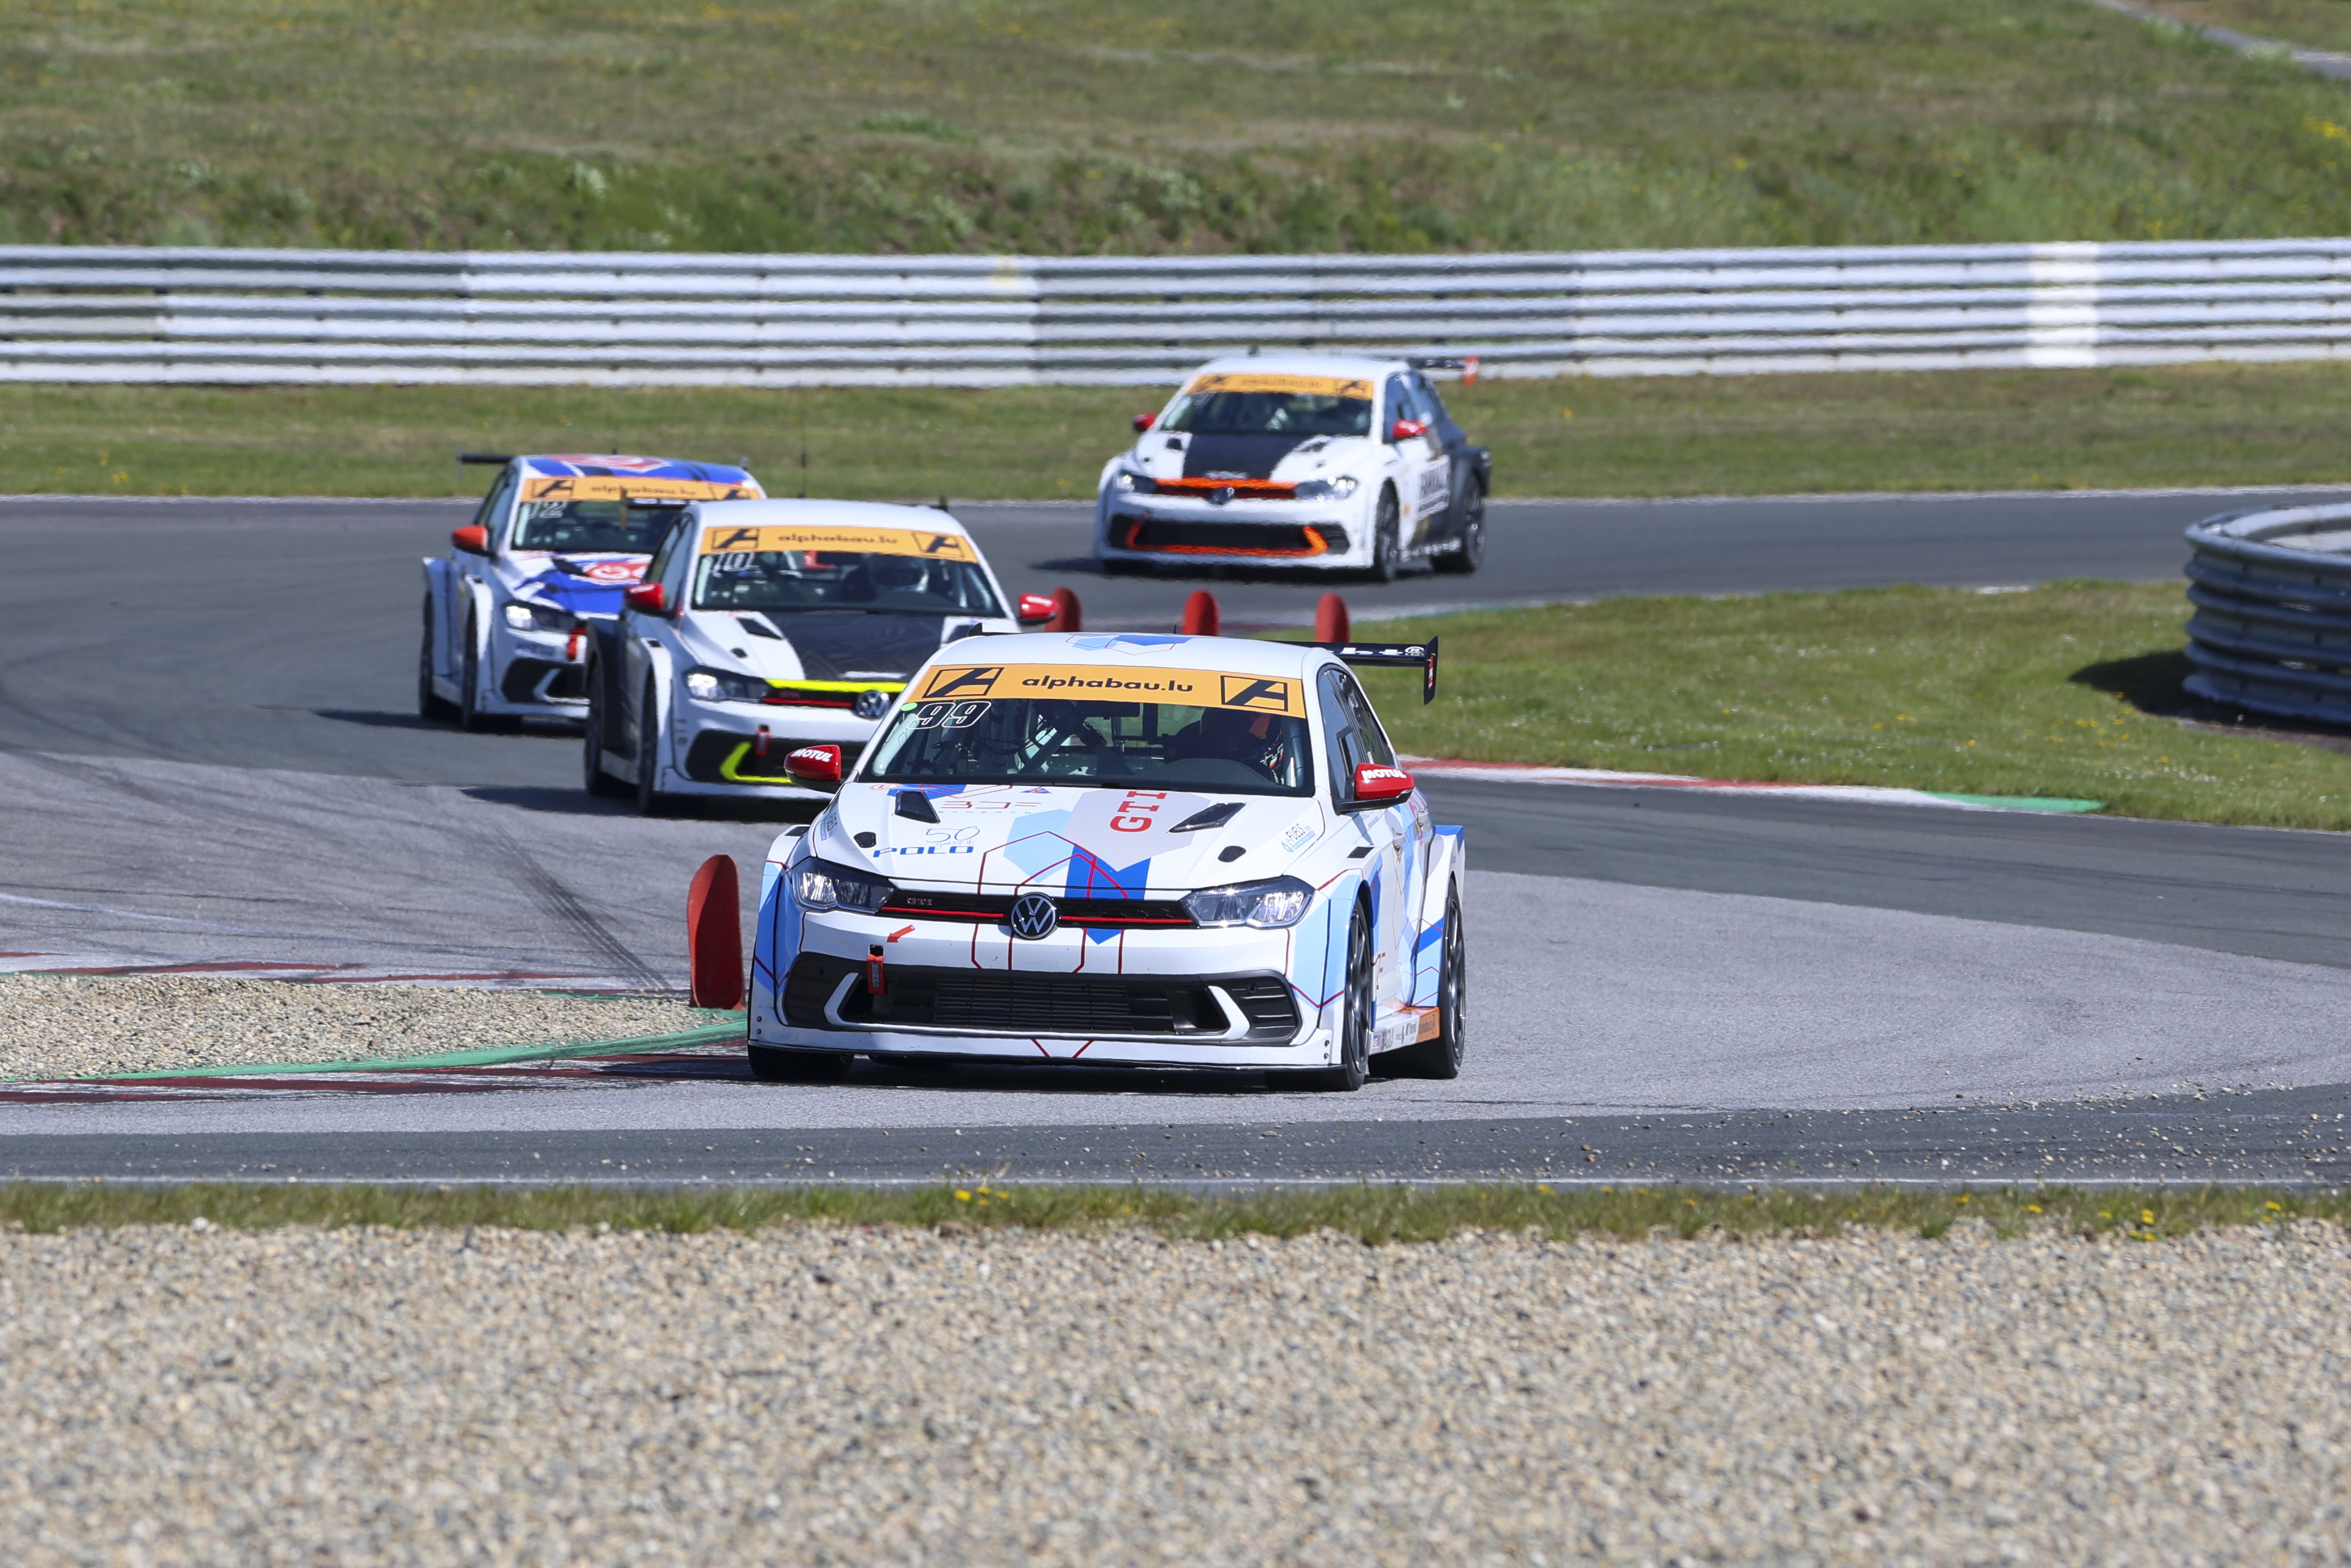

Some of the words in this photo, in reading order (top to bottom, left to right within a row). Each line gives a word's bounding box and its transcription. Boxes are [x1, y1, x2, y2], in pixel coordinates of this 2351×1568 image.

[1022, 675, 1193, 692] alphabau.lu
[907, 701, 991, 729] 99
[790, 749, 833, 762] MOTUL
[1361, 769, 1407, 780] MOTUL
[1110, 791, 1167, 832] GTI
[926, 826, 980, 843] 50
[873, 846, 974, 858] POLO
[907, 898, 932, 906] GTI
